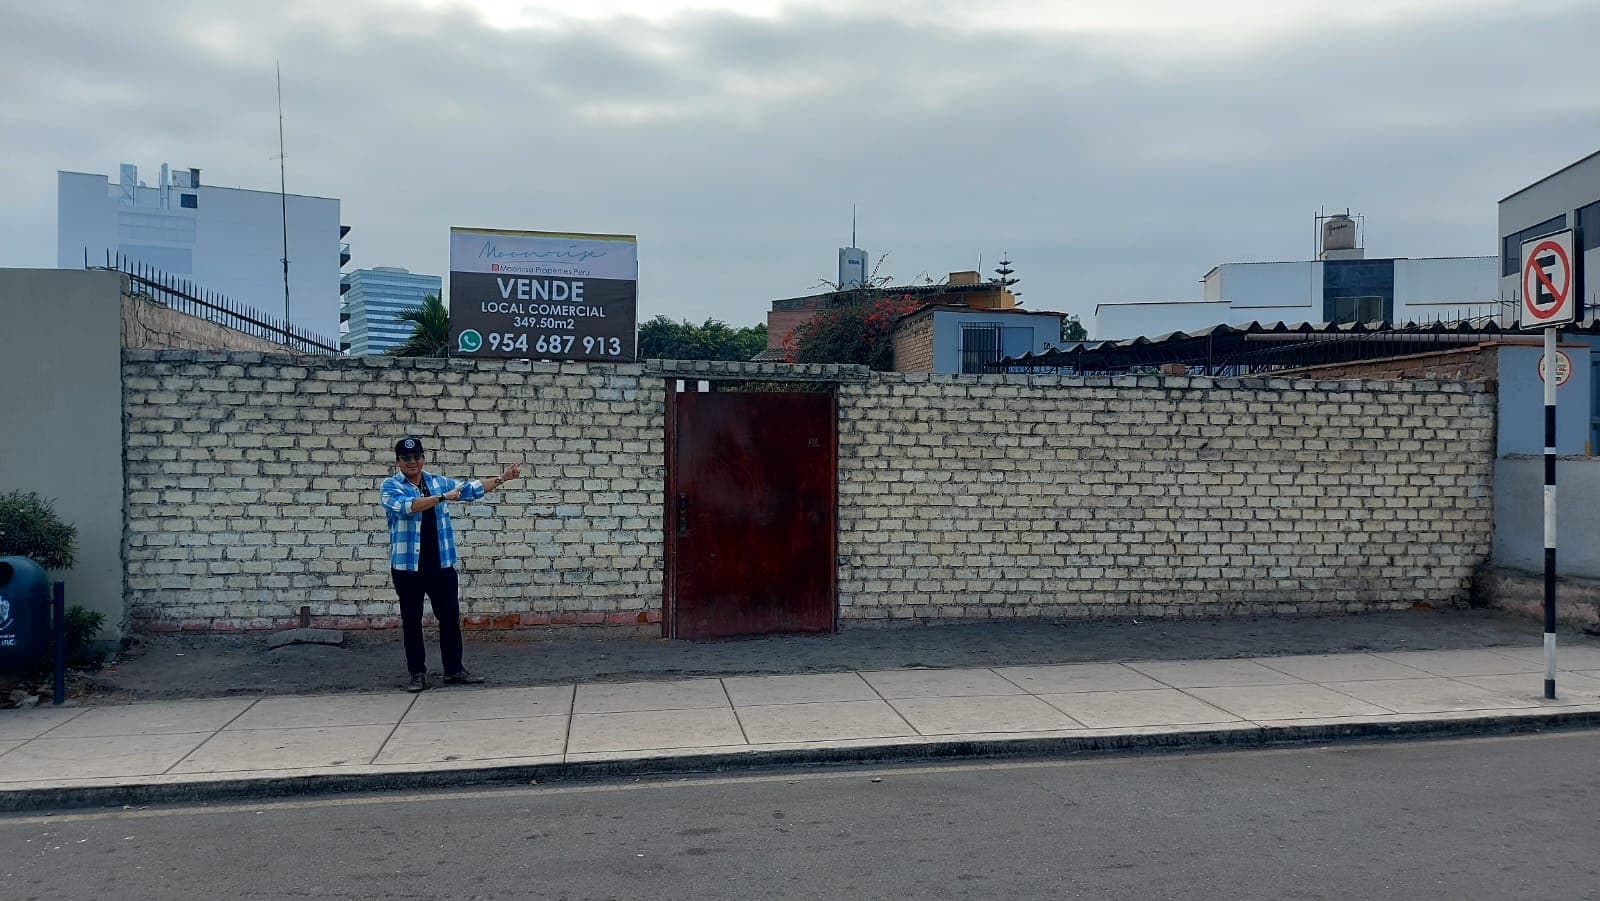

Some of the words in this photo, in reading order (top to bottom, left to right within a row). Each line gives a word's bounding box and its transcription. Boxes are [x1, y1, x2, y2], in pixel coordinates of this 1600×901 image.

[496, 277, 584, 302] VENDE
[1536, 254, 1556, 305] E
[481, 302, 525, 315] LOCAL
[528, 303, 605, 317] COMERCIAL
[513, 316, 575, 329] 349.50m2
[488, 332, 529, 352] 954
[535, 334, 576, 354] 687
[582, 336, 621, 355] 913
